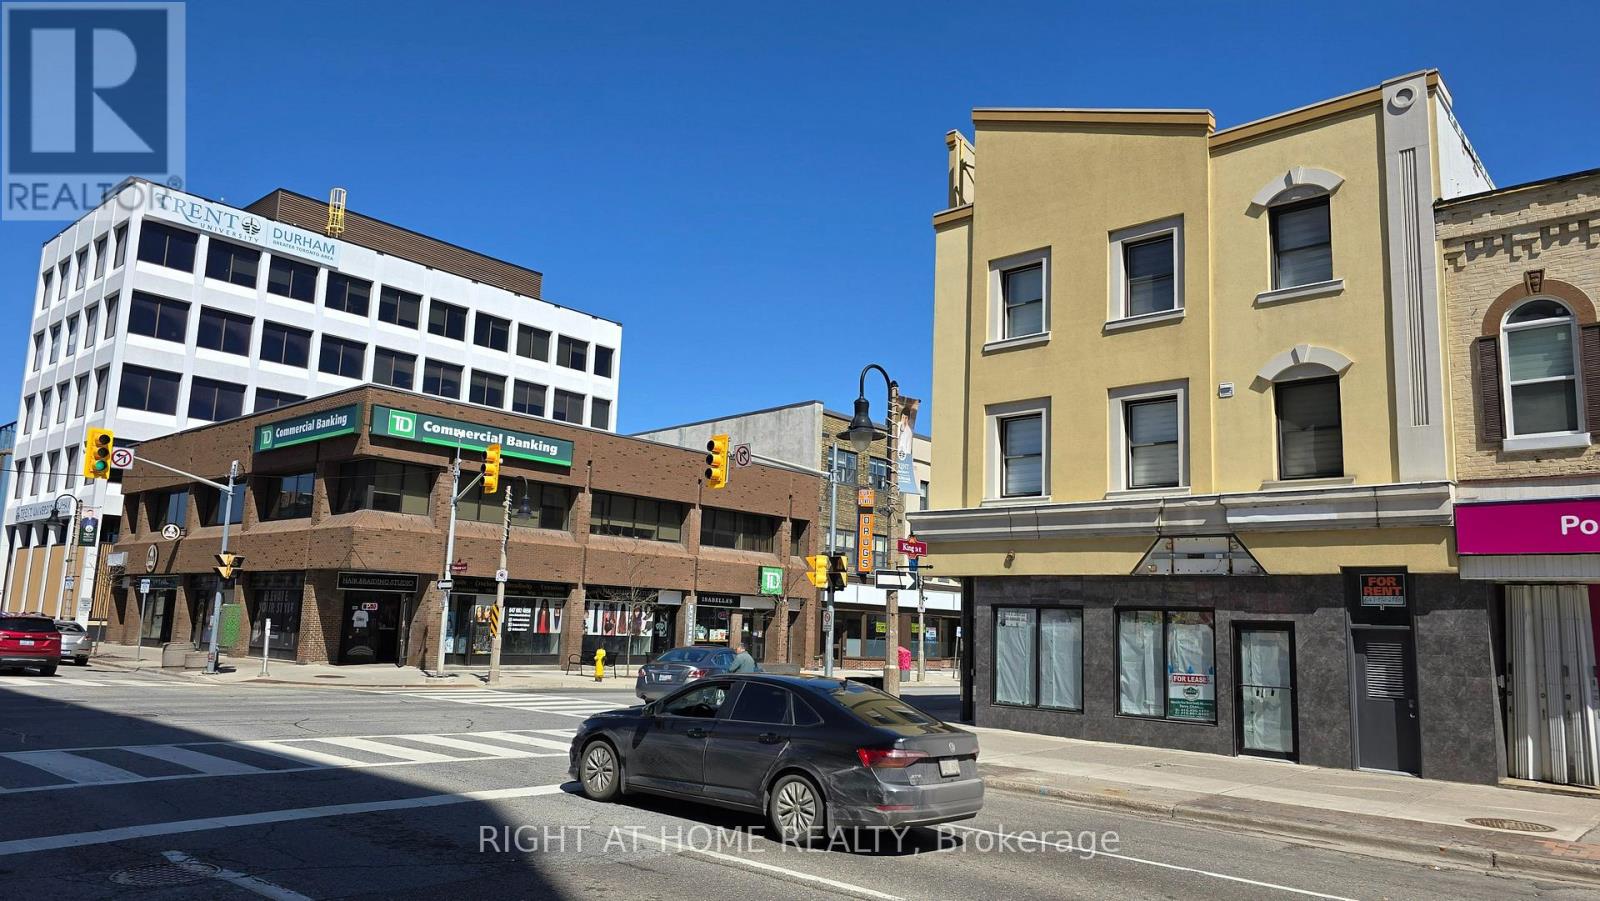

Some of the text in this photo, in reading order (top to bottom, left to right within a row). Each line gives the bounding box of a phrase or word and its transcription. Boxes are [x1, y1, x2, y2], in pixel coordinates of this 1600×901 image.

[155, 192, 240, 230] TRENT
[200, 222, 259, 243] UNIVERSITY
[273, 227, 336, 255] DURHAM
[296, 246, 320, 256] TORONTO
[275, 419, 315, 438] Commercial
[316, 414, 348, 429] Banking
[392, 415, 558, 456] TD Commercial Banking
[1560, 515, 1599, 535] Po
[862, 516, 870, 568] DRUGS
[763, 572, 780, 589] TD
[1364, 586, 1402, 595] RENT
[1368, 576, 1396, 586] FOR
[1187, 676, 1208, 684] LEASE
